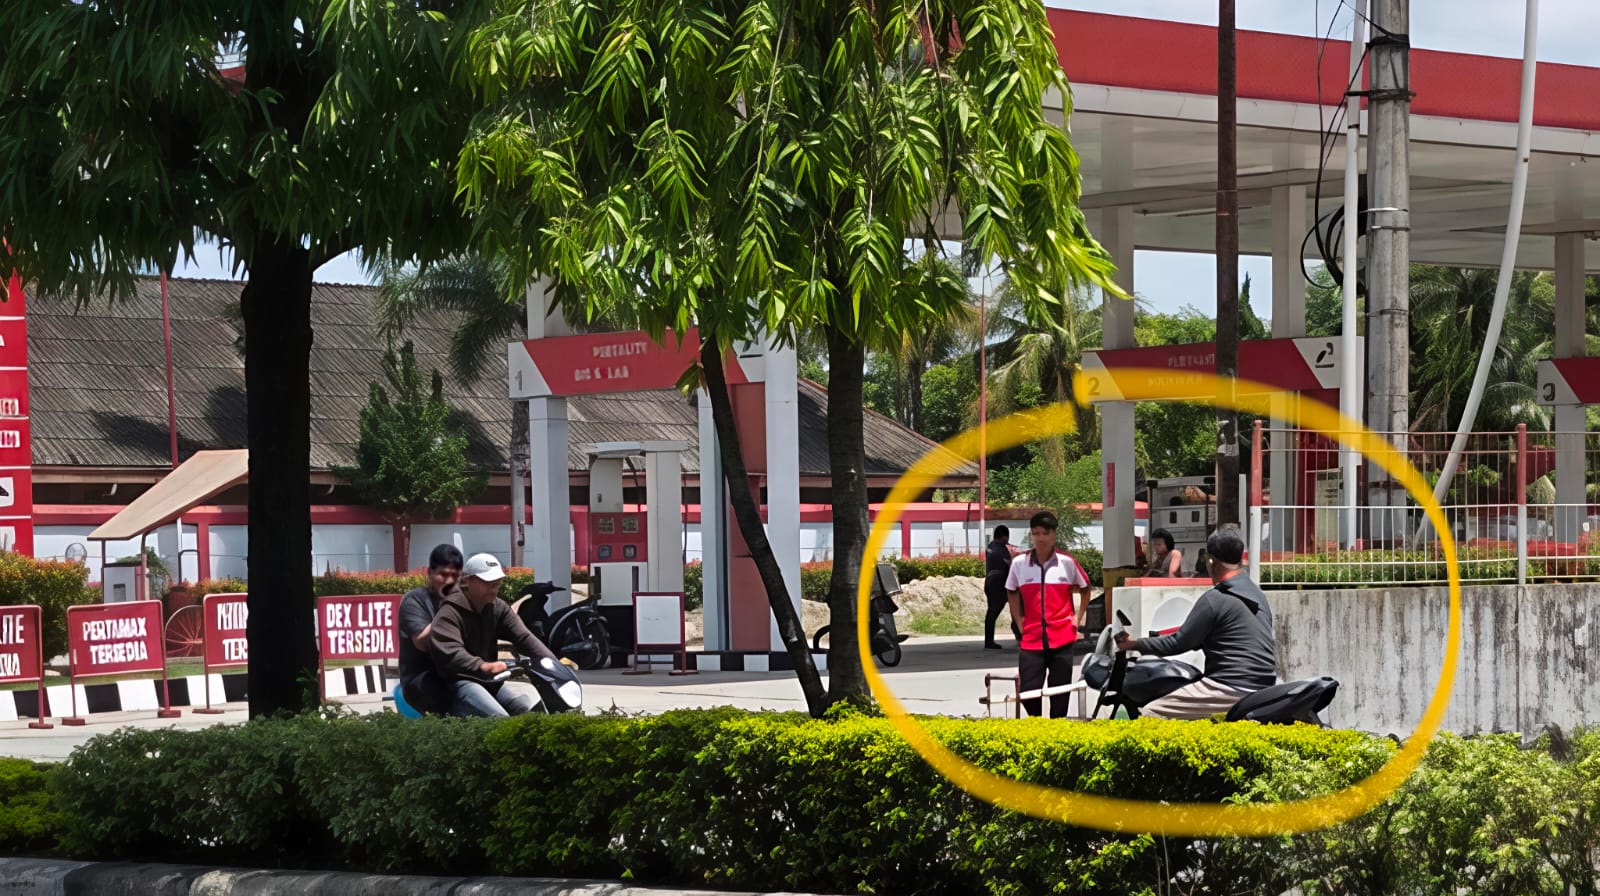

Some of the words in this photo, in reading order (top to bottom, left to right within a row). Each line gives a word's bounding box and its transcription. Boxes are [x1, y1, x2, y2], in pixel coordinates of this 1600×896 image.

[514, 369, 523, 391] 1
[1087, 376, 1100, 396] 2
[326, 603, 352, 628] DEX
[358, 601, 393, 628] LITE
[82, 617, 147, 641] PERTAMAX
[89, 641, 148, 665] TERSEDIA
[327, 629, 394, 655] TERSEDIA
